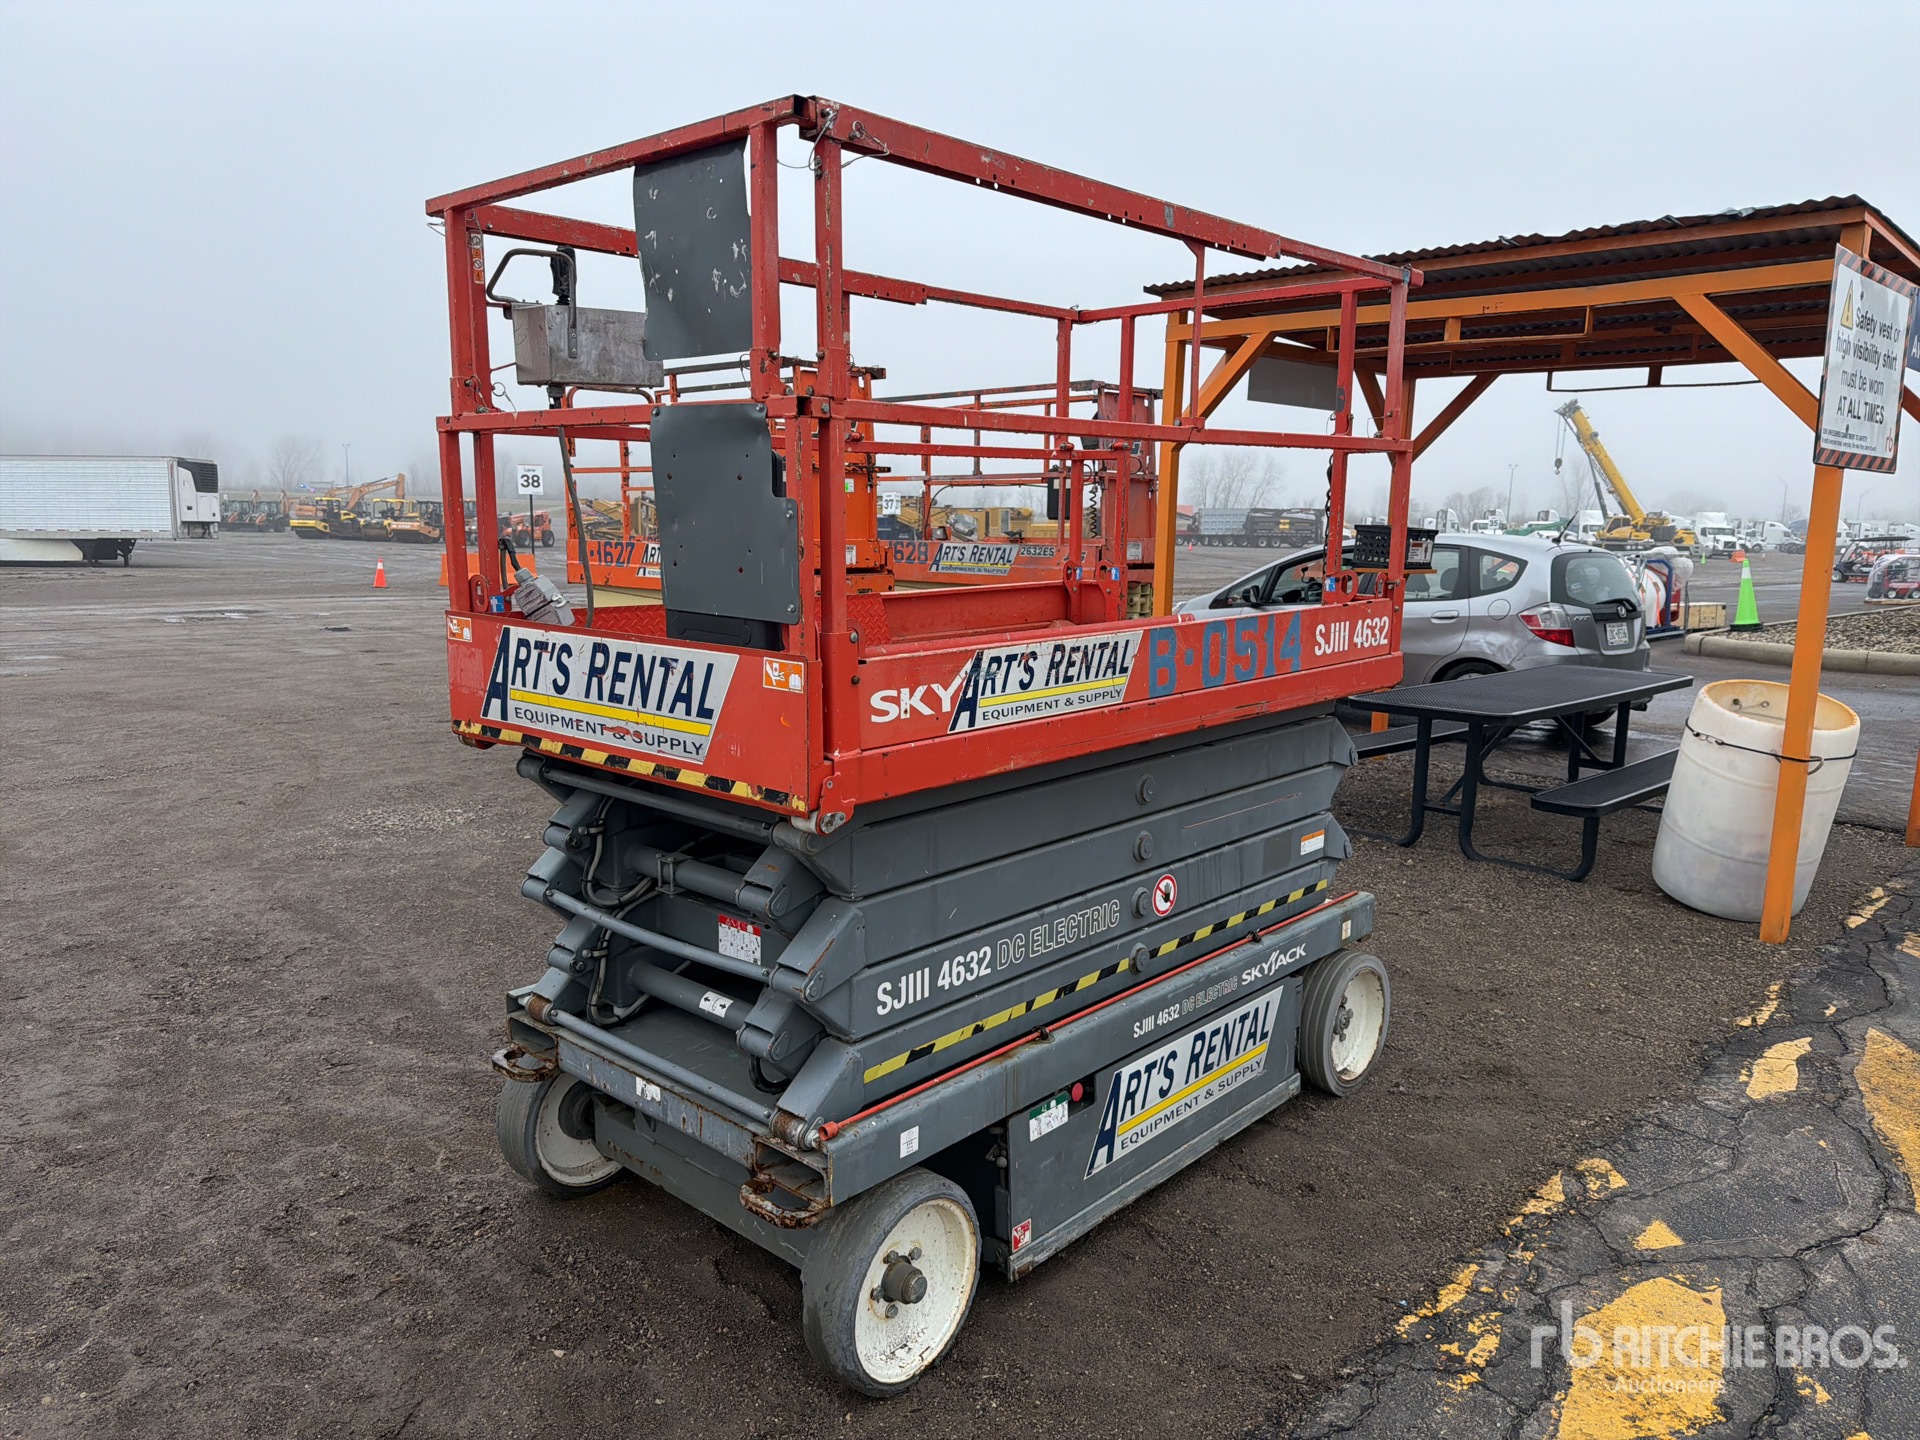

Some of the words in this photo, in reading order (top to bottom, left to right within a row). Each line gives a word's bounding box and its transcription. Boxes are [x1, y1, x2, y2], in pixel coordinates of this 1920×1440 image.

[1855, 307, 1878, 339] Safety
[1879, 321, 1893, 341] vest
[1893, 328, 1901, 343] or
[1836, 330, 1851, 360] high
[1853, 338, 1882, 371] visibility
[1882, 349, 1898, 371] shirt
[1840, 369, 1857, 390] must
[1858, 369, 1867, 392] be
[1868, 378, 1884, 397] worn
[1837, 395, 1847, 417] AT
[1847, 398, 1861, 420] ALL
[1864, 401, 1885, 425] TIMES
[520, 474, 541, 488] 38
[883, 498, 894, 510] 37
[1489, 519, 1498, 527] 35
[930, 543, 967, 571] ART'S
[969, 545, 1013, 564] RENTAL
[1020, 546, 1055, 557] 2632ES
[940, 565, 976, 573] EQUIPMENT
[983, 567, 1008, 575] SUPPLY
[1353, 616, 1389, 649] 4632
[482, 627, 573, 721] ART'S
[584, 642, 714, 720] RENTAL
[949, 650, 1038, 732] ART'S
[1045, 639, 1130, 687] RENTAL
[982, 702, 1061, 721] EQUIPMENT
[1064, 697, 1074, 707] &
[1077, 688, 1123, 705] SUPPLY
[514, 706, 607, 736] EQUIPMENT
[612, 728, 627, 741] &
[632, 730, 704, 756] SUPPLY
[876, 967, 930, 1016] SJIII
[937, 946, 992, 990] 4632
[997, 933, 1025, 971] DC
[1029, 899, 1120, 958] ELECTRIC
[1241, 943, 1307, 986] SKYJACK
[1133, 1020, 1155, 1038] SJIII
[1157, 1004, 1180, 1027] 4632
[1181, 998, 1195, 1016] DC
[1195, 976, 1239, 1009] ELECTRIC
[1086, 1050, 1178, 1177] ART'S
[1184, 1000, 1270, 1085] RENTAL
[1120, 1094, 1200, 1150] EQUIPMENT
[1204, 1088, 1214, 1100] &
[1218, 1058, 1263, 1092] SUPPLY
